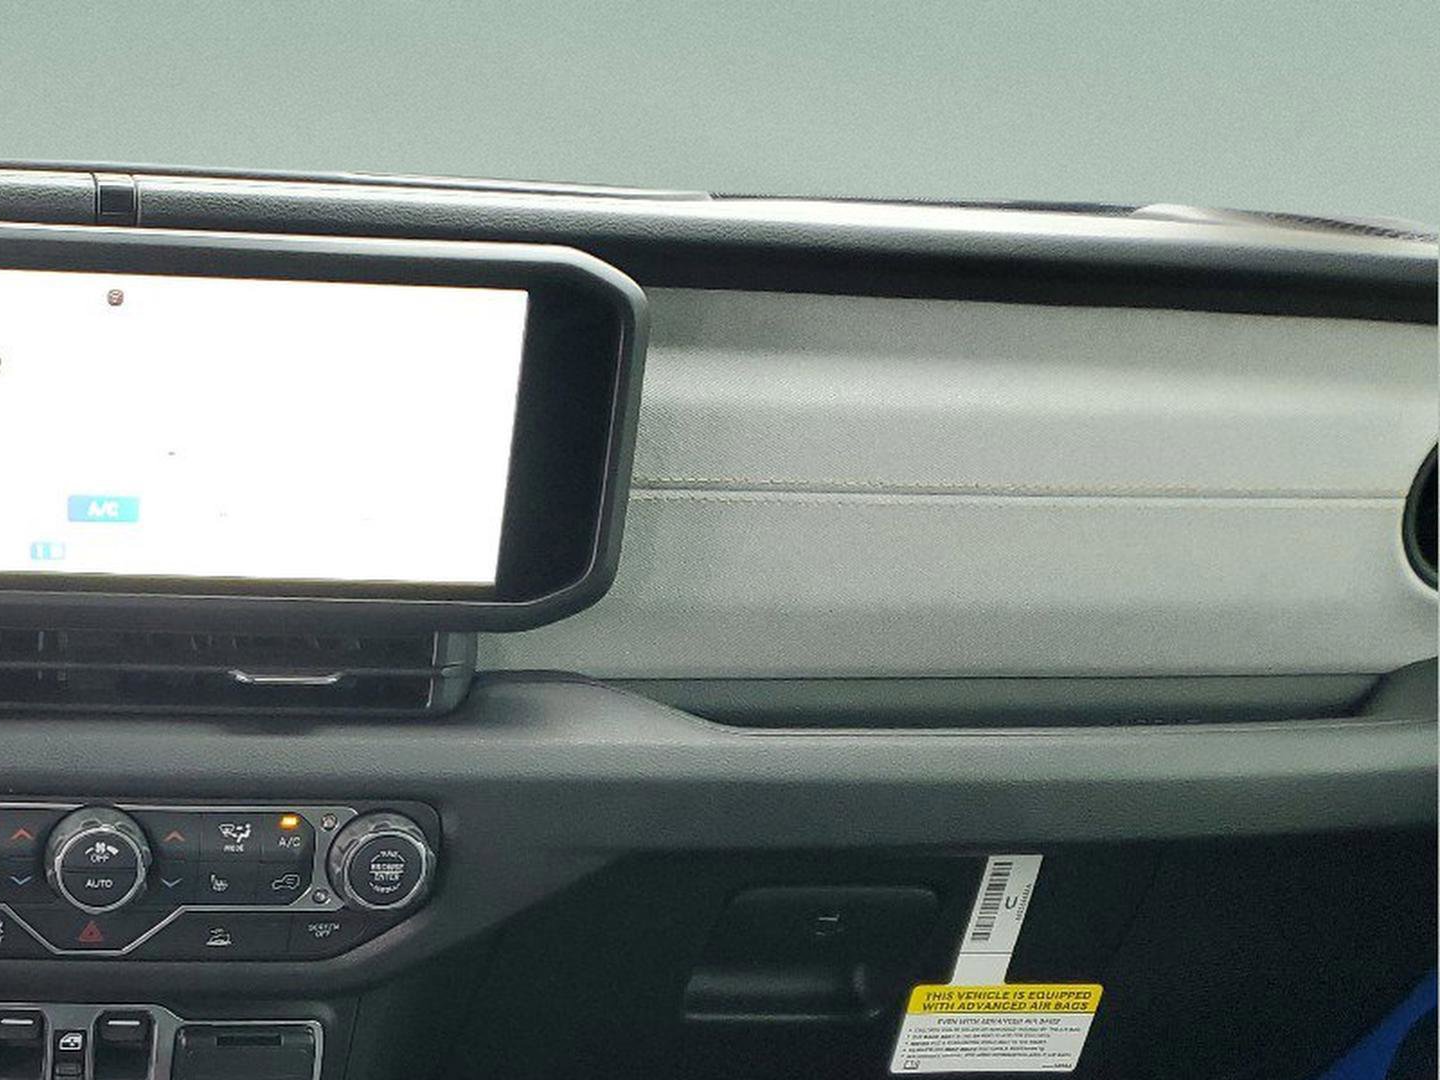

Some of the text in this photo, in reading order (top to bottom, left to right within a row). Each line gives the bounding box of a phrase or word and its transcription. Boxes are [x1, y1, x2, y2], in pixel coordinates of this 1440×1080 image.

[87, 500, 120, 516] A/C
[279, 836, 301, 848] A/C
[85, 879, 113, 888] AUTO
[926, 991, 1092, 1000] THIS VEHICLE IS EQUIPPED
[922, 1002, 1089, 1011] WITH ADVANCED AIR BAGS
